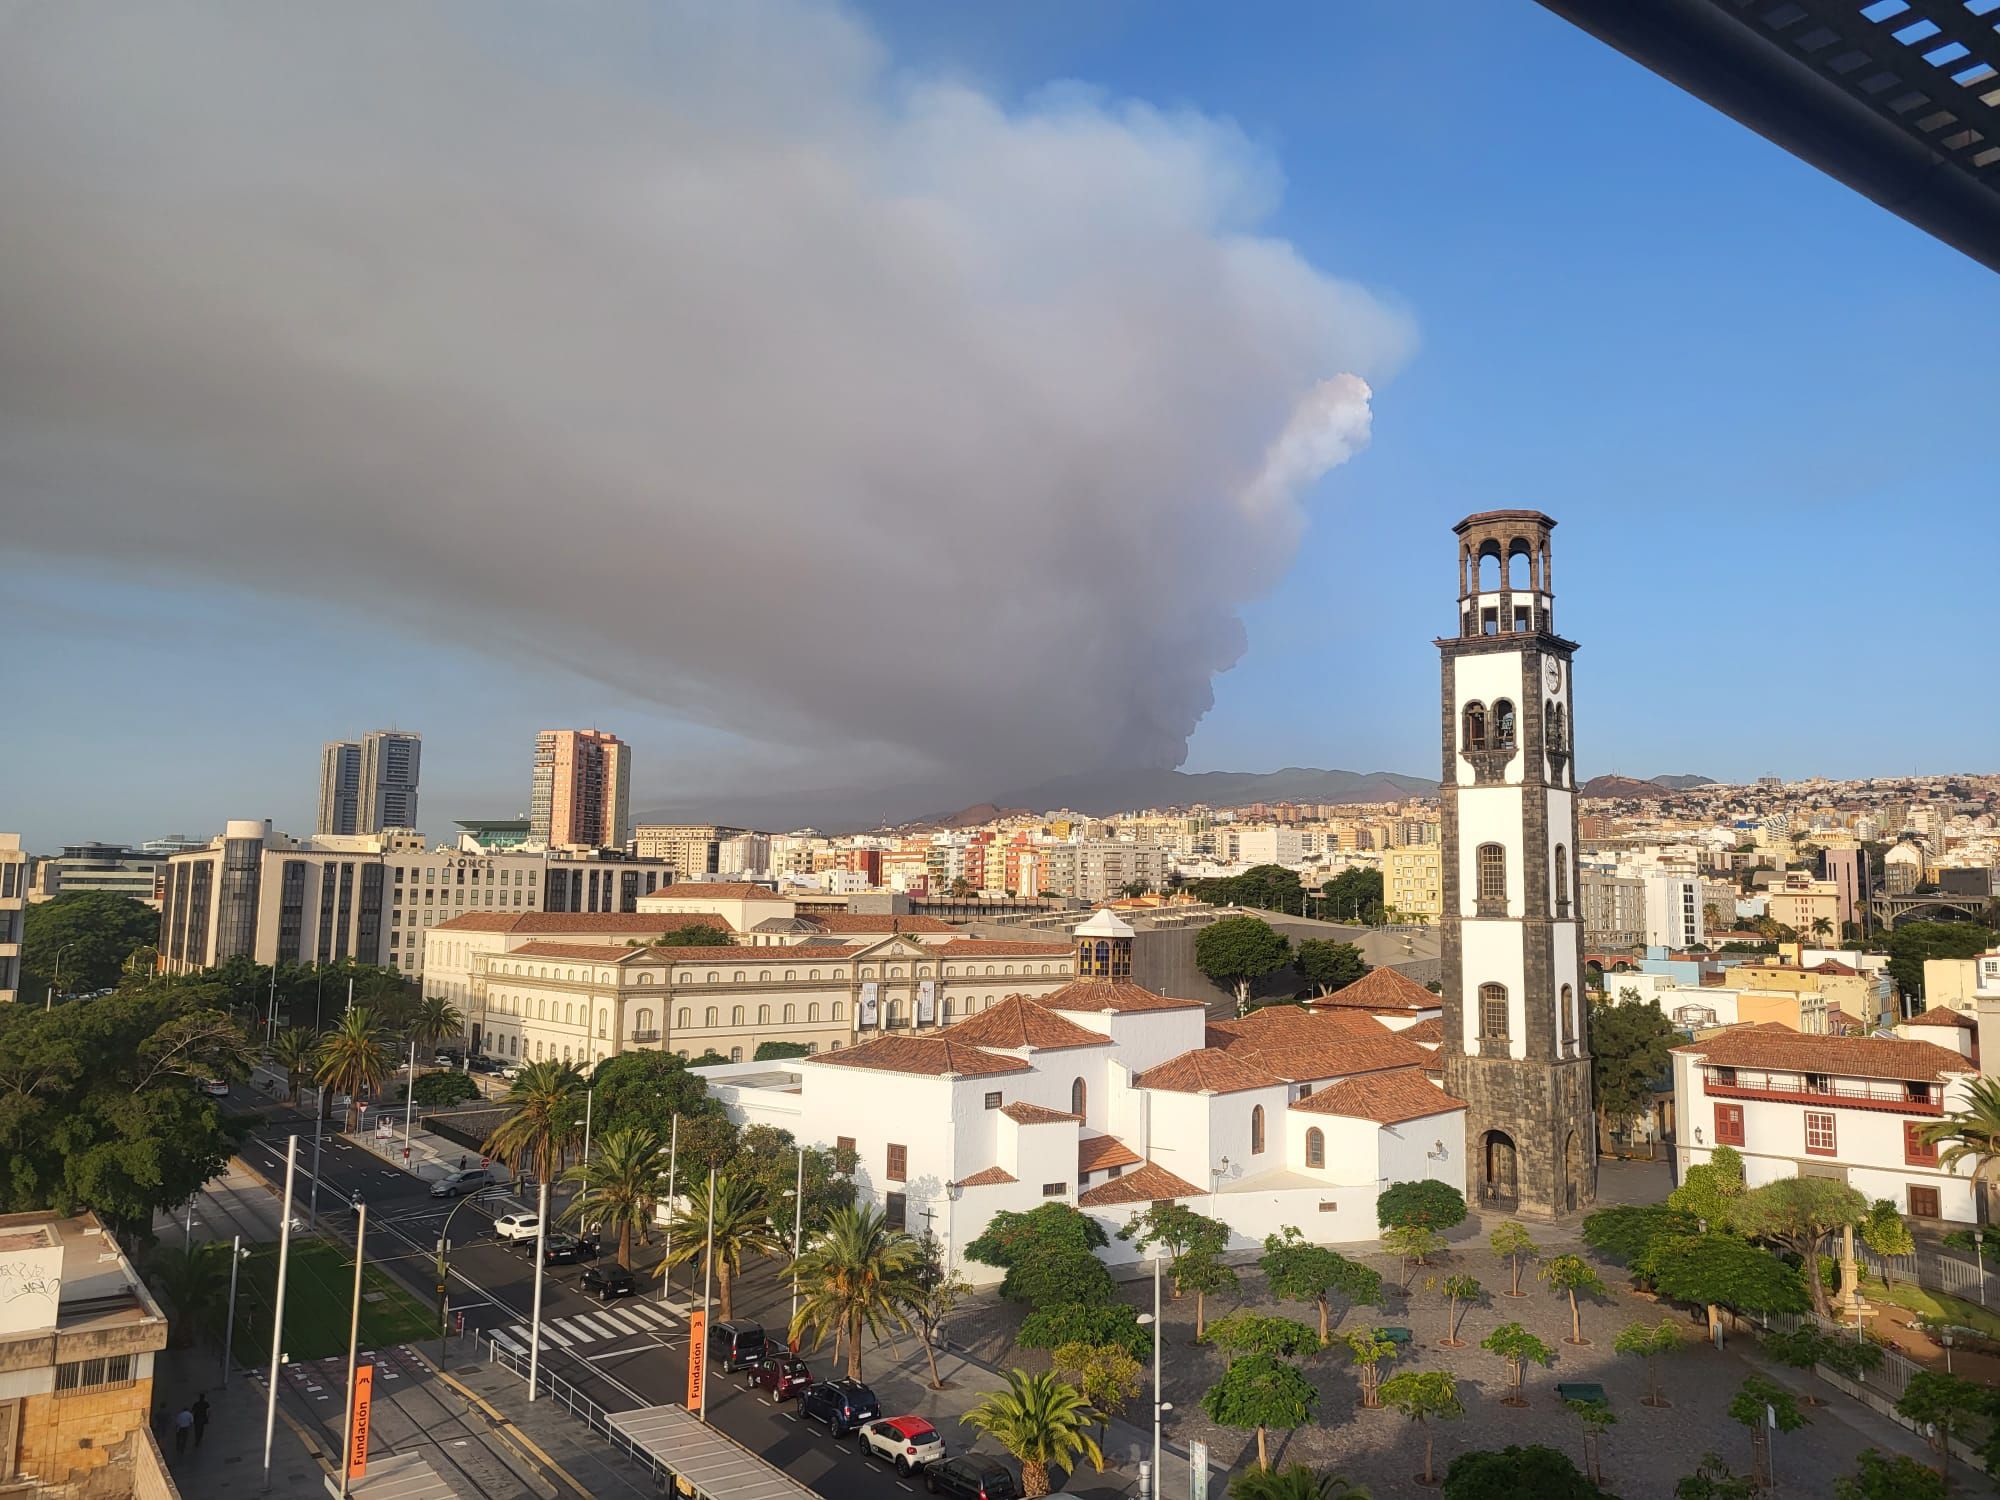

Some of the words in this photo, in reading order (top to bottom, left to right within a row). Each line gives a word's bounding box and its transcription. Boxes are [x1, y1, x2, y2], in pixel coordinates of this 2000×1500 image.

[457, 858, 494, 868] ONCE
[691, 1342, 701, 1399] Fundación
[354, 1401, 368, 1466] Fundación
